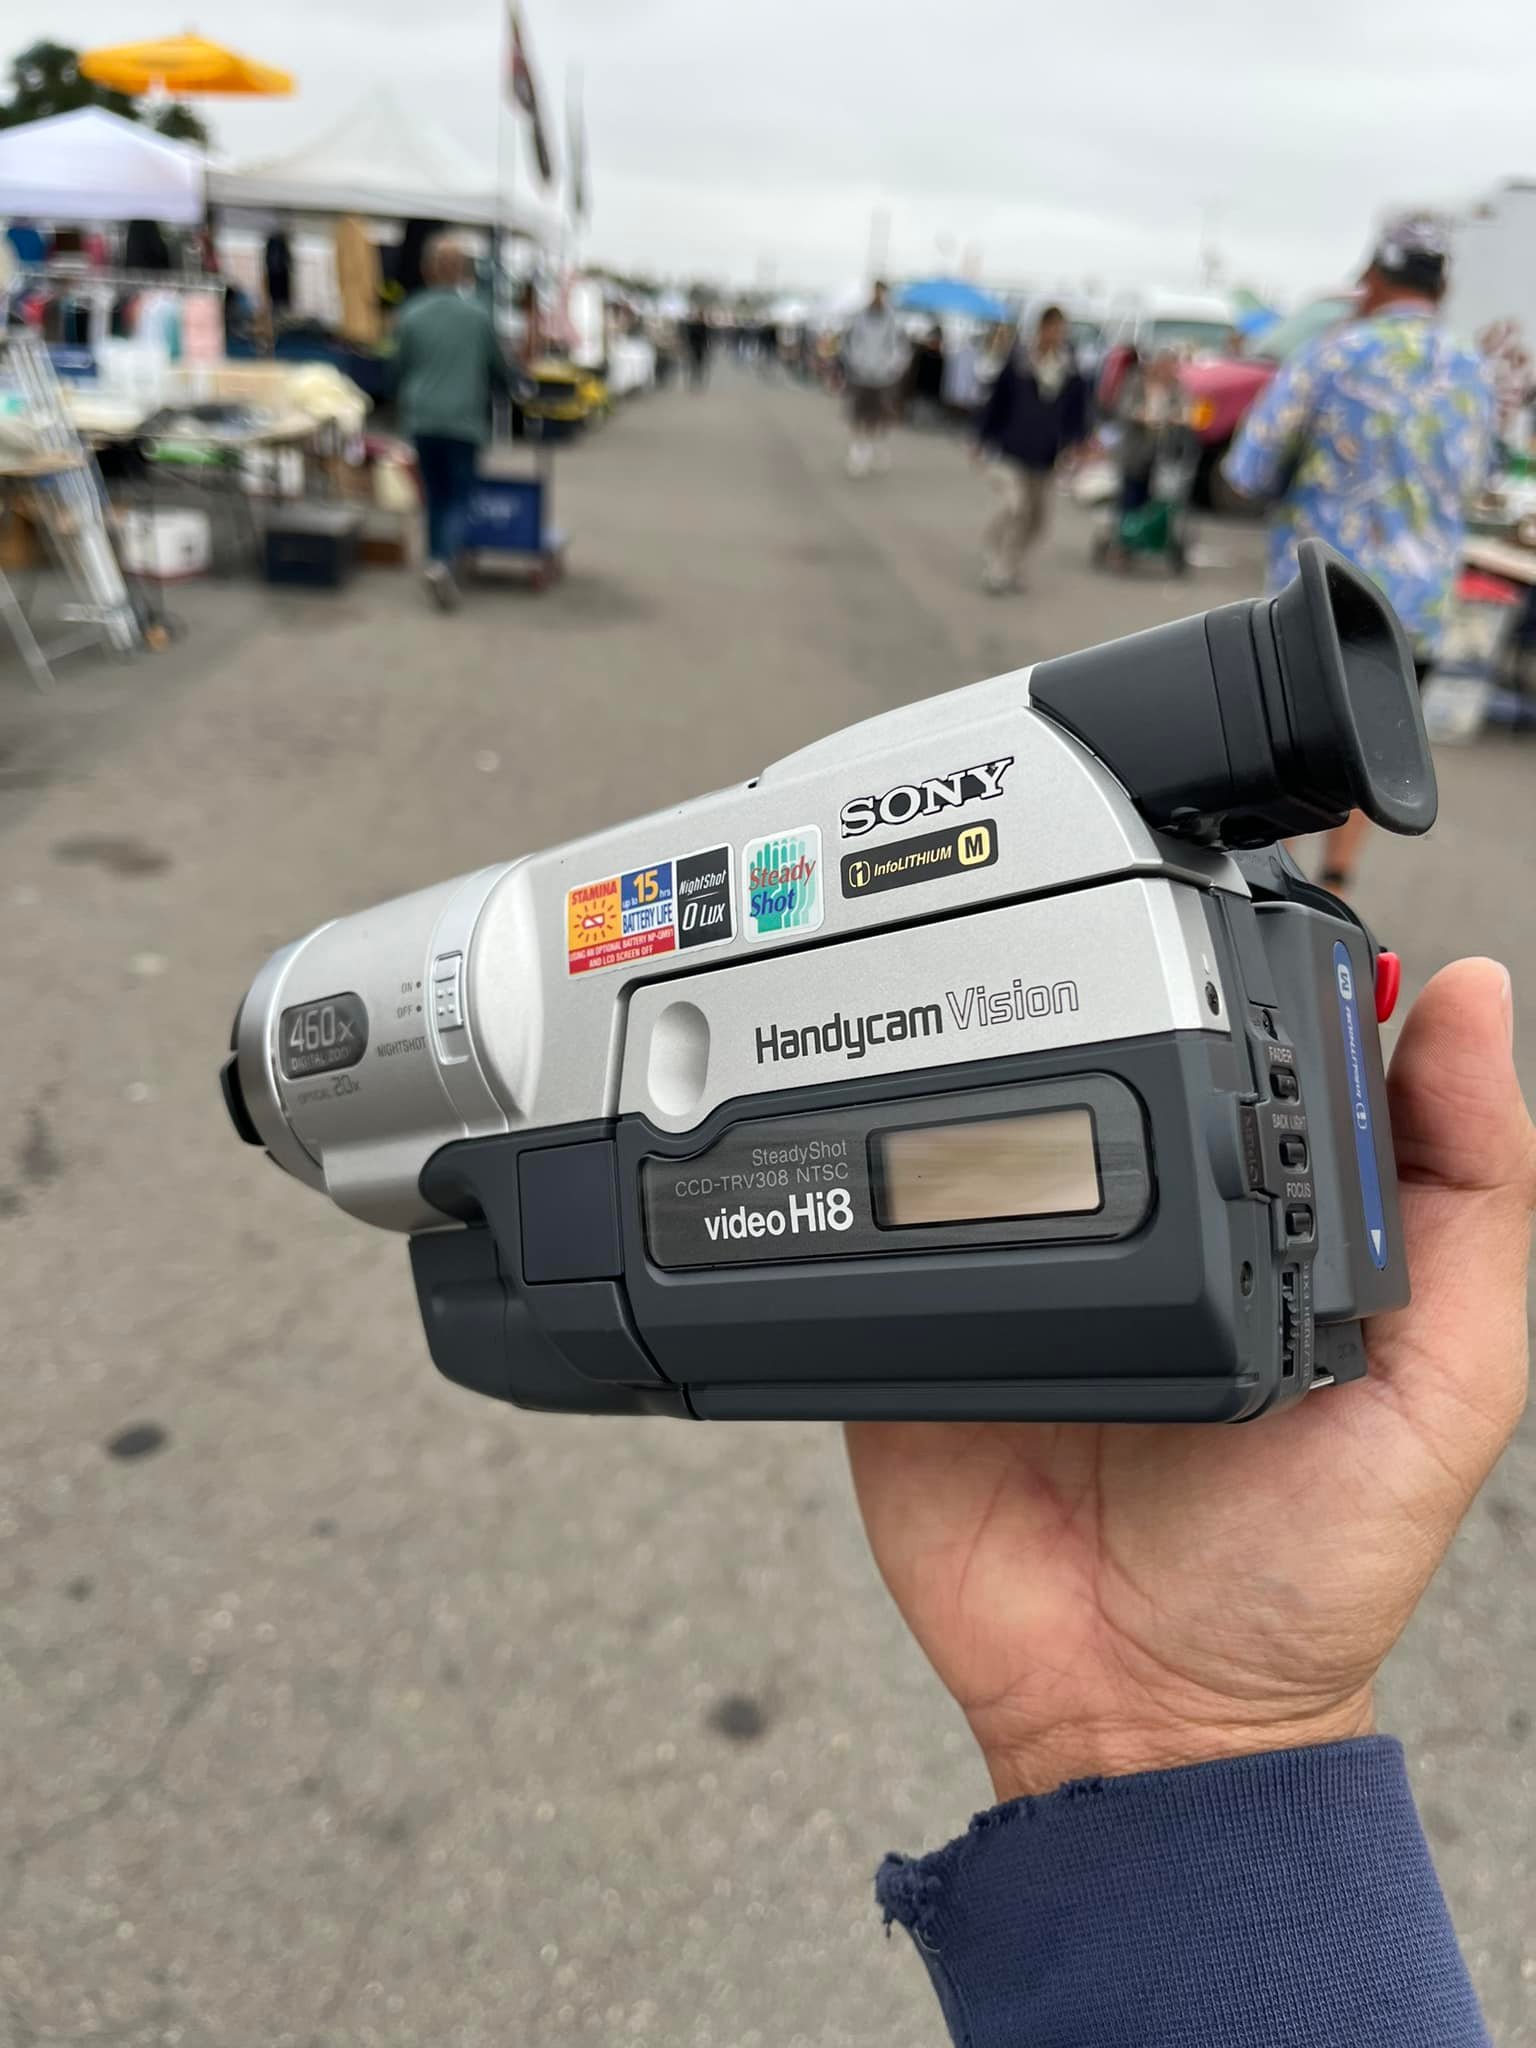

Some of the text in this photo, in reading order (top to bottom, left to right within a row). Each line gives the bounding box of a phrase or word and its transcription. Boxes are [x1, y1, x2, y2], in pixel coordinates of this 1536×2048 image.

[840, 757, 1015, 838] SONY
[873, 833, 983, 877] InfoLITHIUM M
[633, 869, 659, 903] 15
[659, 888, 671, 898] hrs
[679, 869, 727, 896] NightShot
[748, 855, 816, 890] Steady
[571, 881, 617, 905] STAMINA
[750, 888, 796, 917] Shot
[623, 902, 673, 934] BATTERY LIFE
[623, 935, 647, 949] BATTERY
[589, 945, 653, 968] AND LCD SCREEN OFF
[401, 982, 413, 994] ON
[397, 1005, 413, 1018] OFF
[755, 979, 1079, 1064] Handycam Vision
[377, 1036, 426, 1058] NIGHTSHOT
[1268, 1046, 1293, 1063] FADER
[1272, 1113, 1306, 1130] BACK LIGHT
[752, 1140, 848, 1167] SteadyShot
[675, 1162, 849, 1197] CCD-TRV308 NTSC
[1286, 1182, 1311, 1198] FOCUS
[704, 1188, 854, 1240] video Hi8
